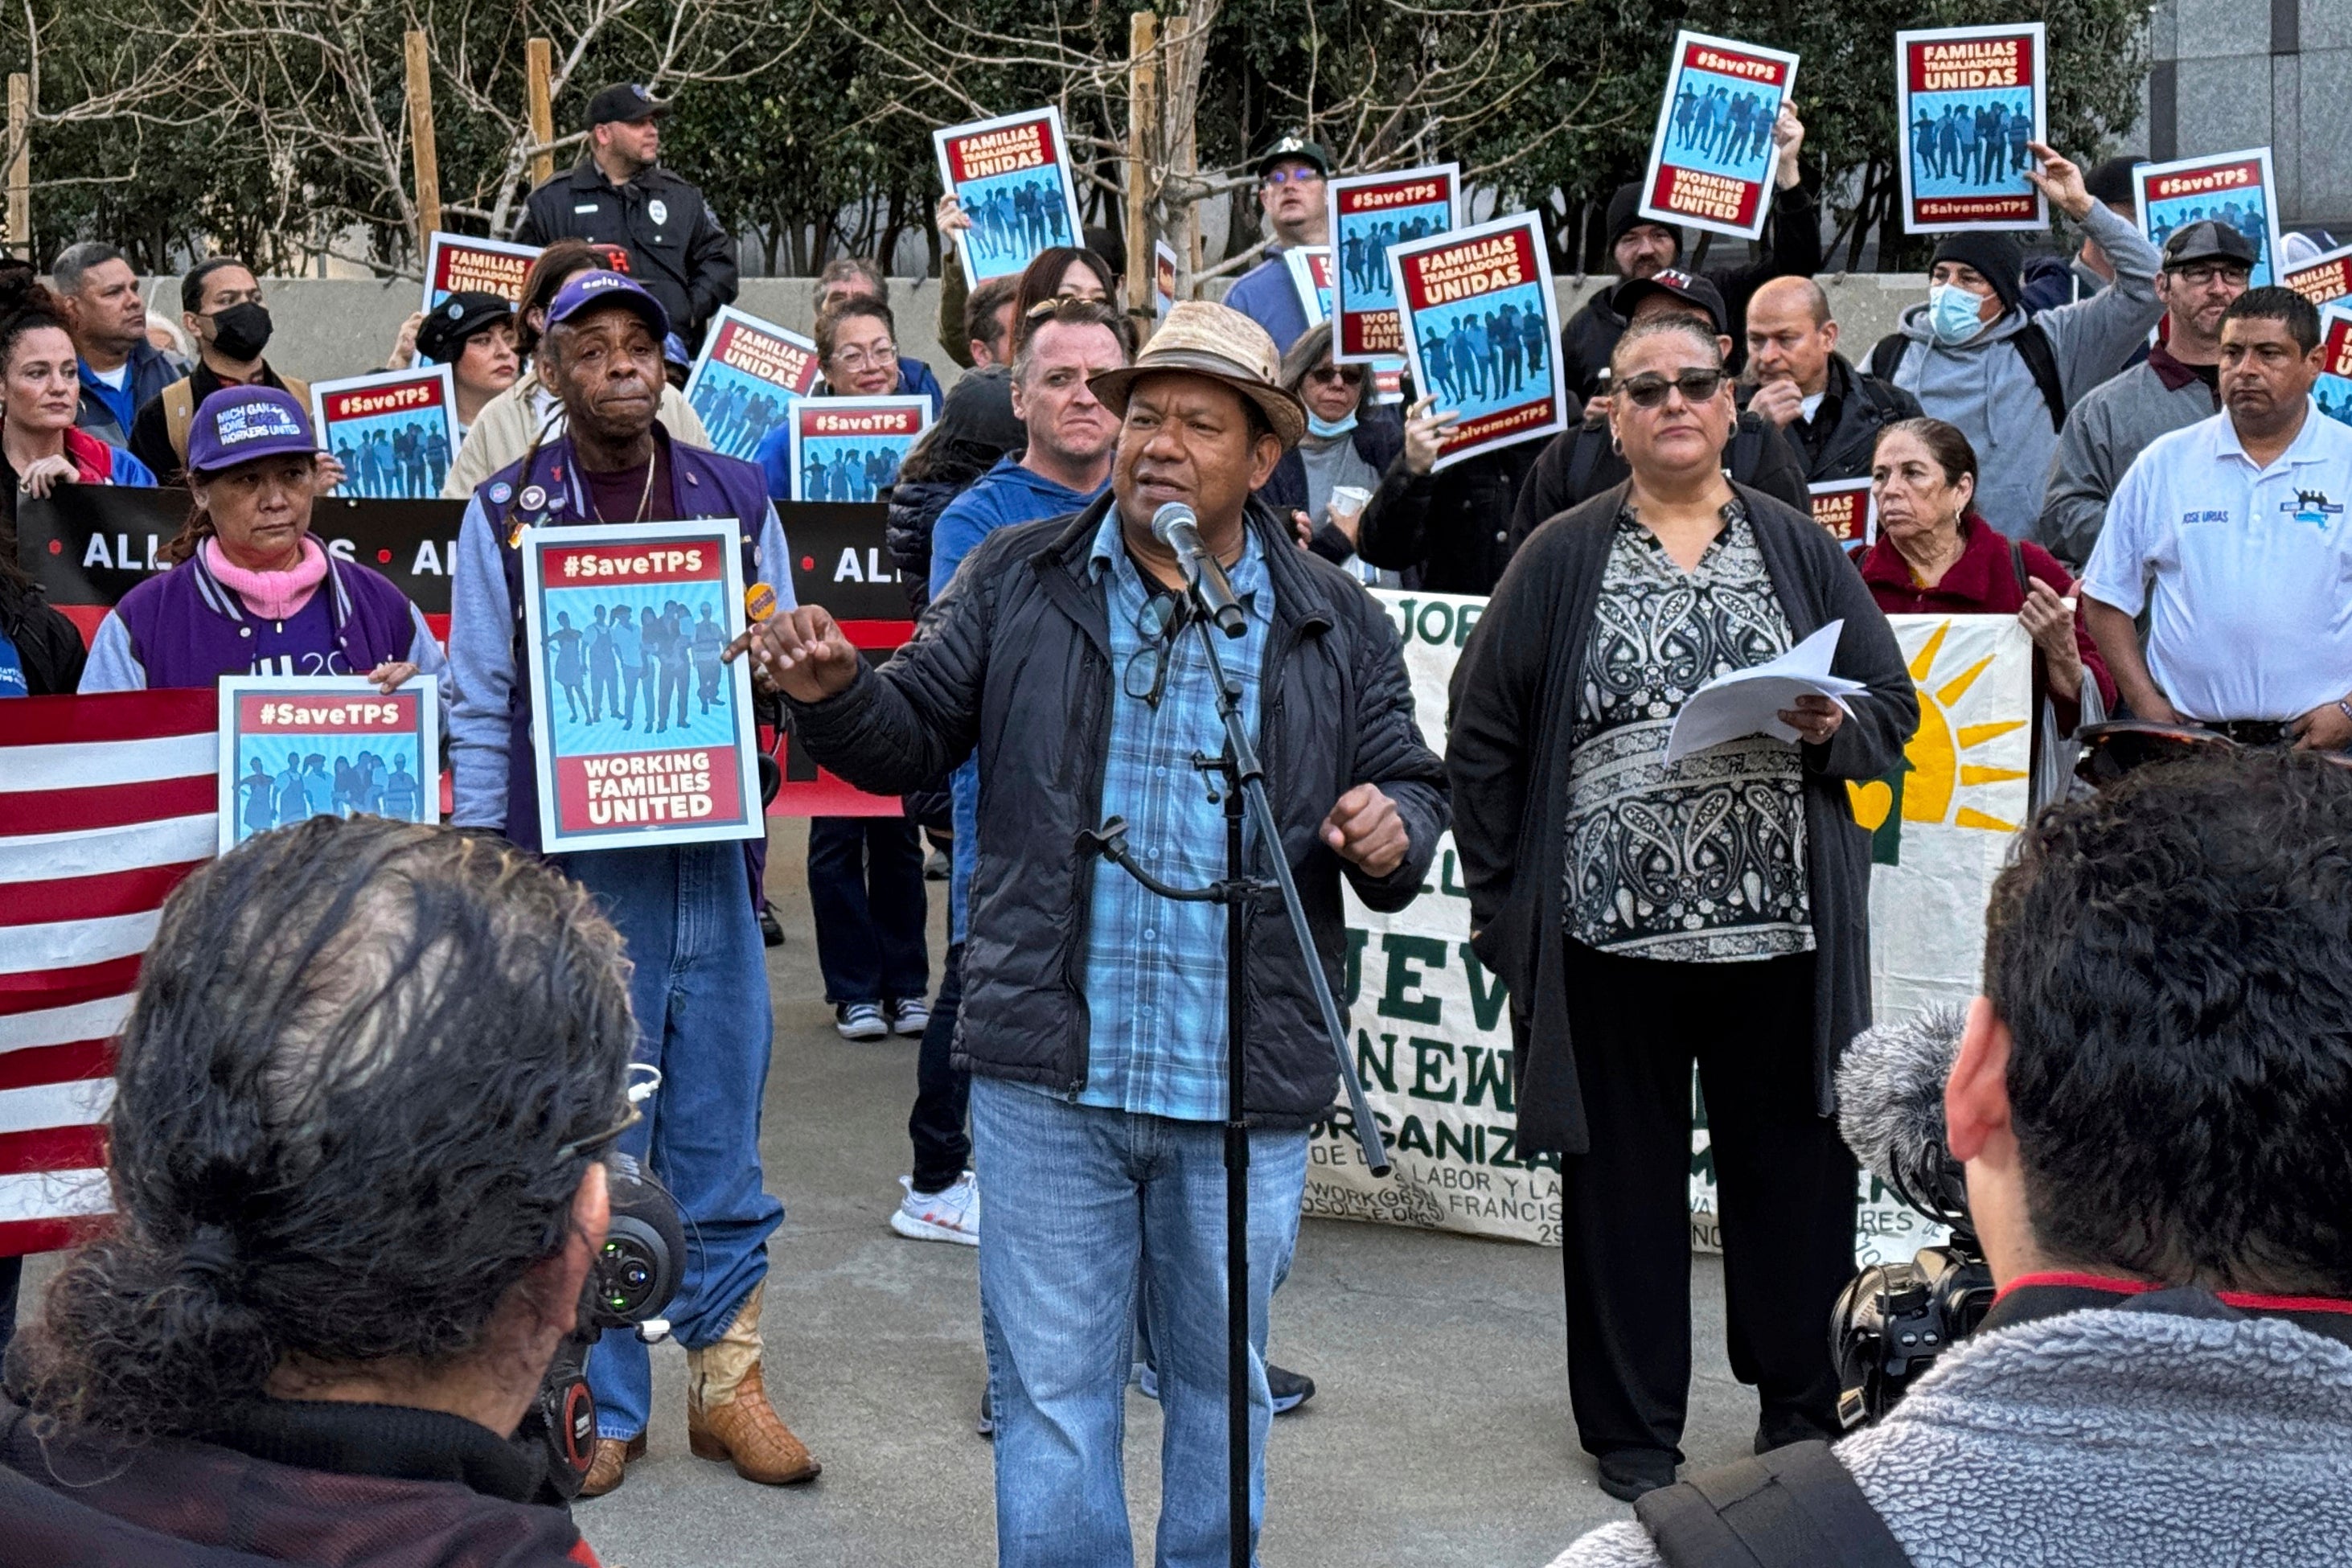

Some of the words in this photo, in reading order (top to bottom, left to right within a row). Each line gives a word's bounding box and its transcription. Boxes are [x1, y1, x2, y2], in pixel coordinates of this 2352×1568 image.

[1923, 41, 2017, 60] FAMILIAS
[1697, 51, 1776, 80] #SaveTPS
[1923, 57, 2017, 72] TRABAJADORAS
[1924, 68, 2018, 89] UNIDAS
[959, 125, 1039, 154] FAMILIAS
[962, 139, 1041, 163] TRABAJADORAS
[964, 149, 1044, 178] UNIDAS
[1673, 181, 1743, 206] FAMILIES
[1676, 169, 1746, 193] WORKING
[2160, 168, 2248, 195] #SaveTPS
[1353, 183, 1437, 208] #SaveTPS
[1669, 193, 1740, 220] UNITED
[1921, 201, 2030, 215] #SalvemosTPS
[450, 250, 526, 273] FAMILIAS
[1418, 236, 1517, 273] FAMILIAS
[449, 264, 523, 285] TRABAJADORAS
[1422, 252, 1519, 285] TRABAJADORAS
[448, 275, 522, 301] UNIDAS
[1424, 265, 1522, 304] UNIDAS
[733, 326, 809, 366] FAMILIAS
[724, 347, 799, 389] UNIDAS
[340, 386, 430, 416] #SaveTPS
[816, 414, 908, 431] #SaveTPS
[82, 532, 173, 571] ALL
[564, 549, 703, 577] #SaveTPS
[834, 547, 902, 583] AL
[260, 703, 400, 725] #SaveTPS
[583, 752, 711, 778] WORKING
[588, 772, 712, 800] FAMILIES
[589, 794, 713, 825] UNITED
[1357, 1028, 1516, 1114] NEW
[1311, 1145, 1348, 1166] DE
[1412, 1164, 1492, 1192] LABOR
[1503, 1176, 1519, 1198] Y
